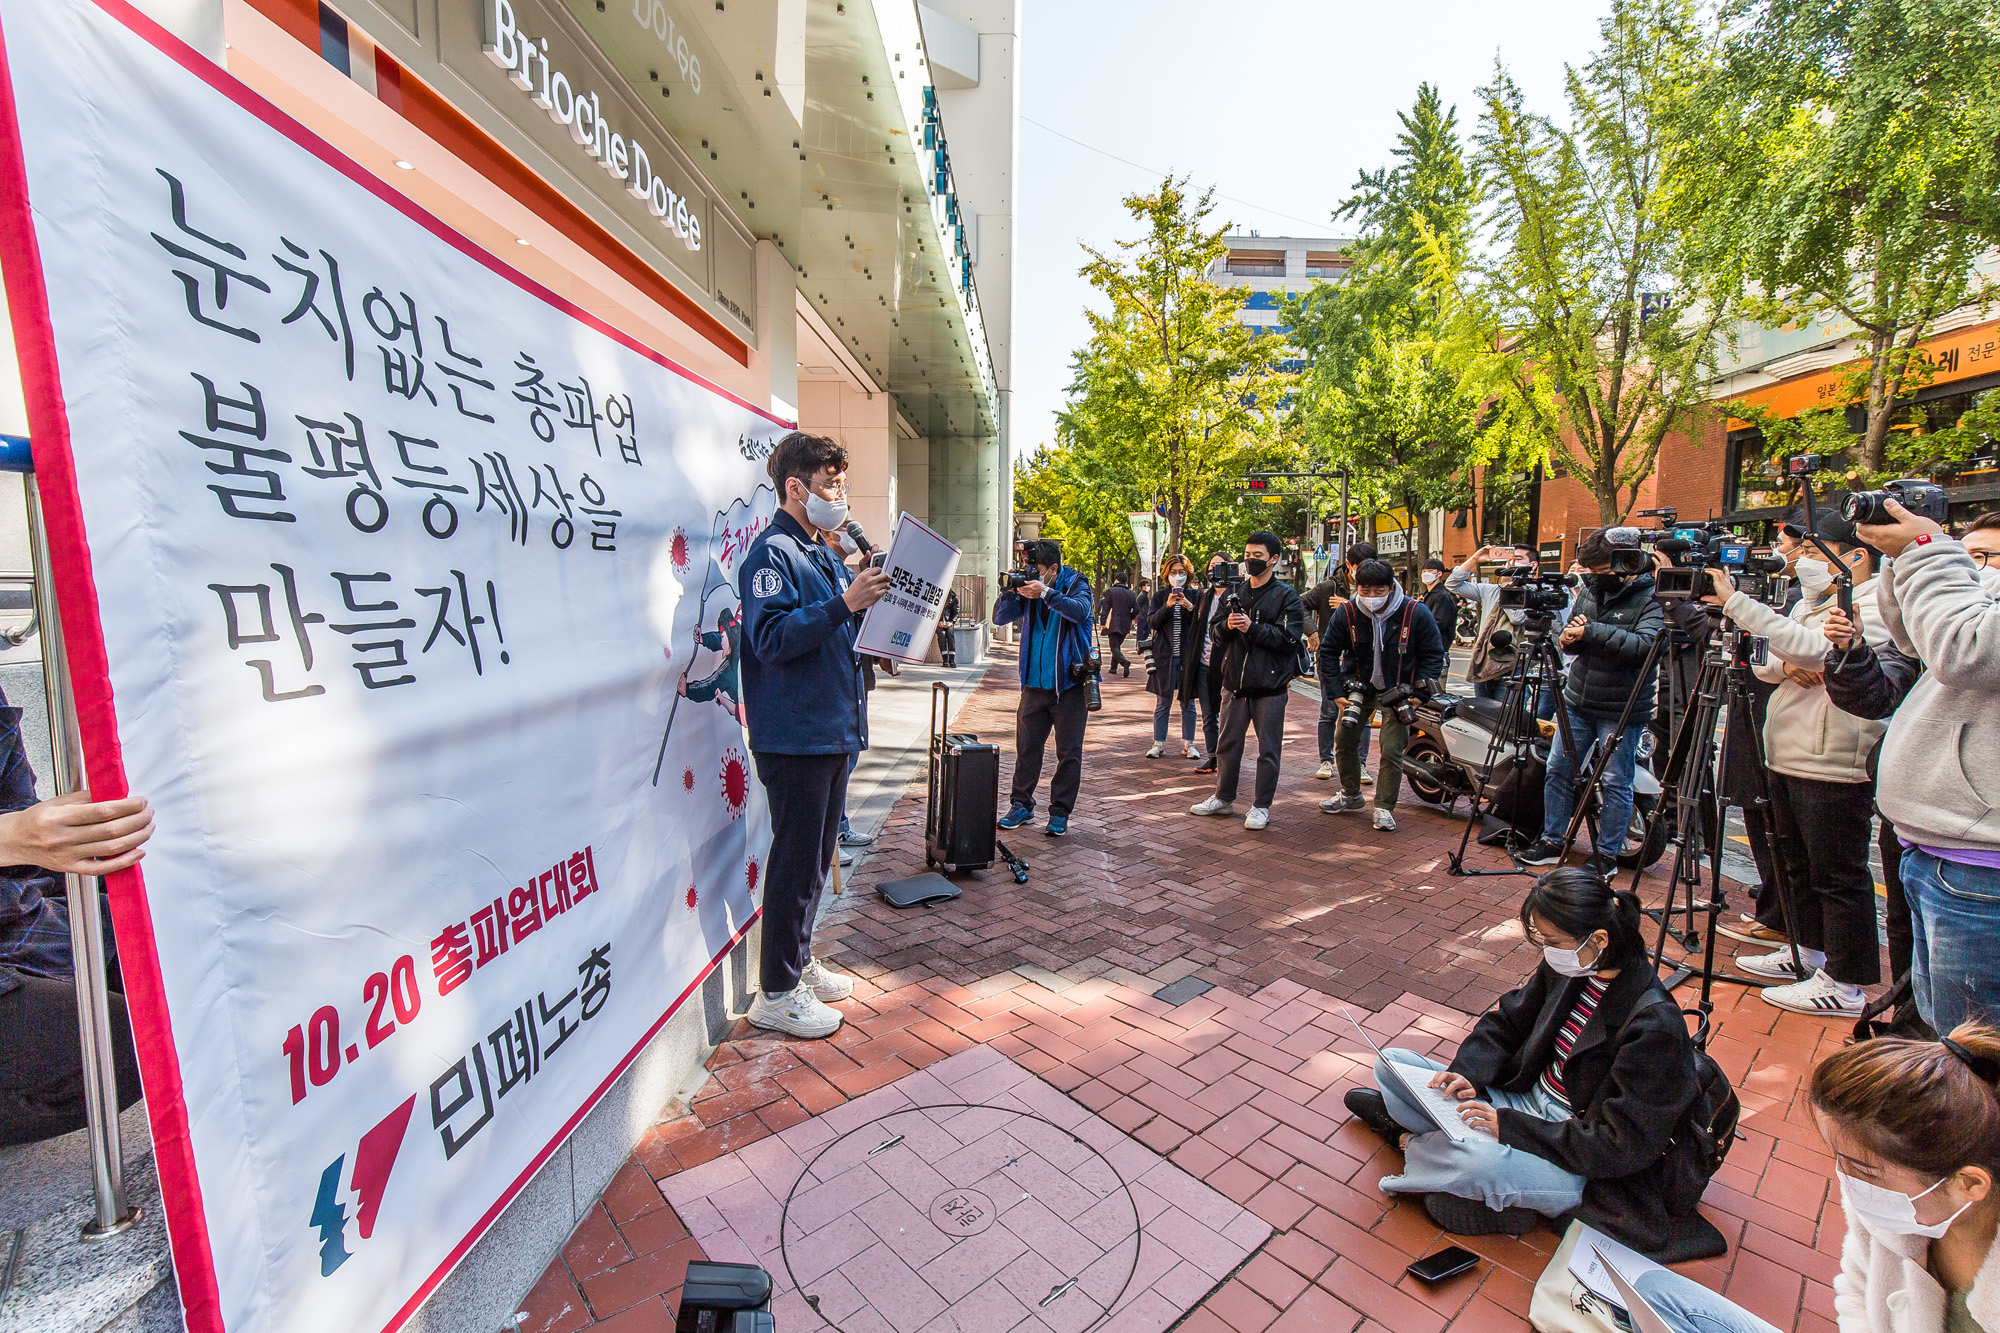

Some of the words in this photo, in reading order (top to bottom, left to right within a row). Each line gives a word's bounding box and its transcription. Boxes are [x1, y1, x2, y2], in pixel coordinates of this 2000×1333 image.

[490, 0, 629, 181] Brioche
[628, 138, 701, 252] Dorée
[150, 167, 496, 424] 눈치없는
[511, 350, 643, 468] 총파업
[1967, 340, 2000, 362] 전문
[178, 371, 623, 558] 불평등세상을
[1251, 481, 1265, 490] 단속
[206, 562, 511, 702] 만들자!
[889, 565, 924, 598] 민주노총
[920, 581, 944, 606] 고발장
[282, 954, 421, 1106] 10.20
[429, 844, 600, 997] 총파업대회
[428, 941, 612, 1162] 민폐노총
